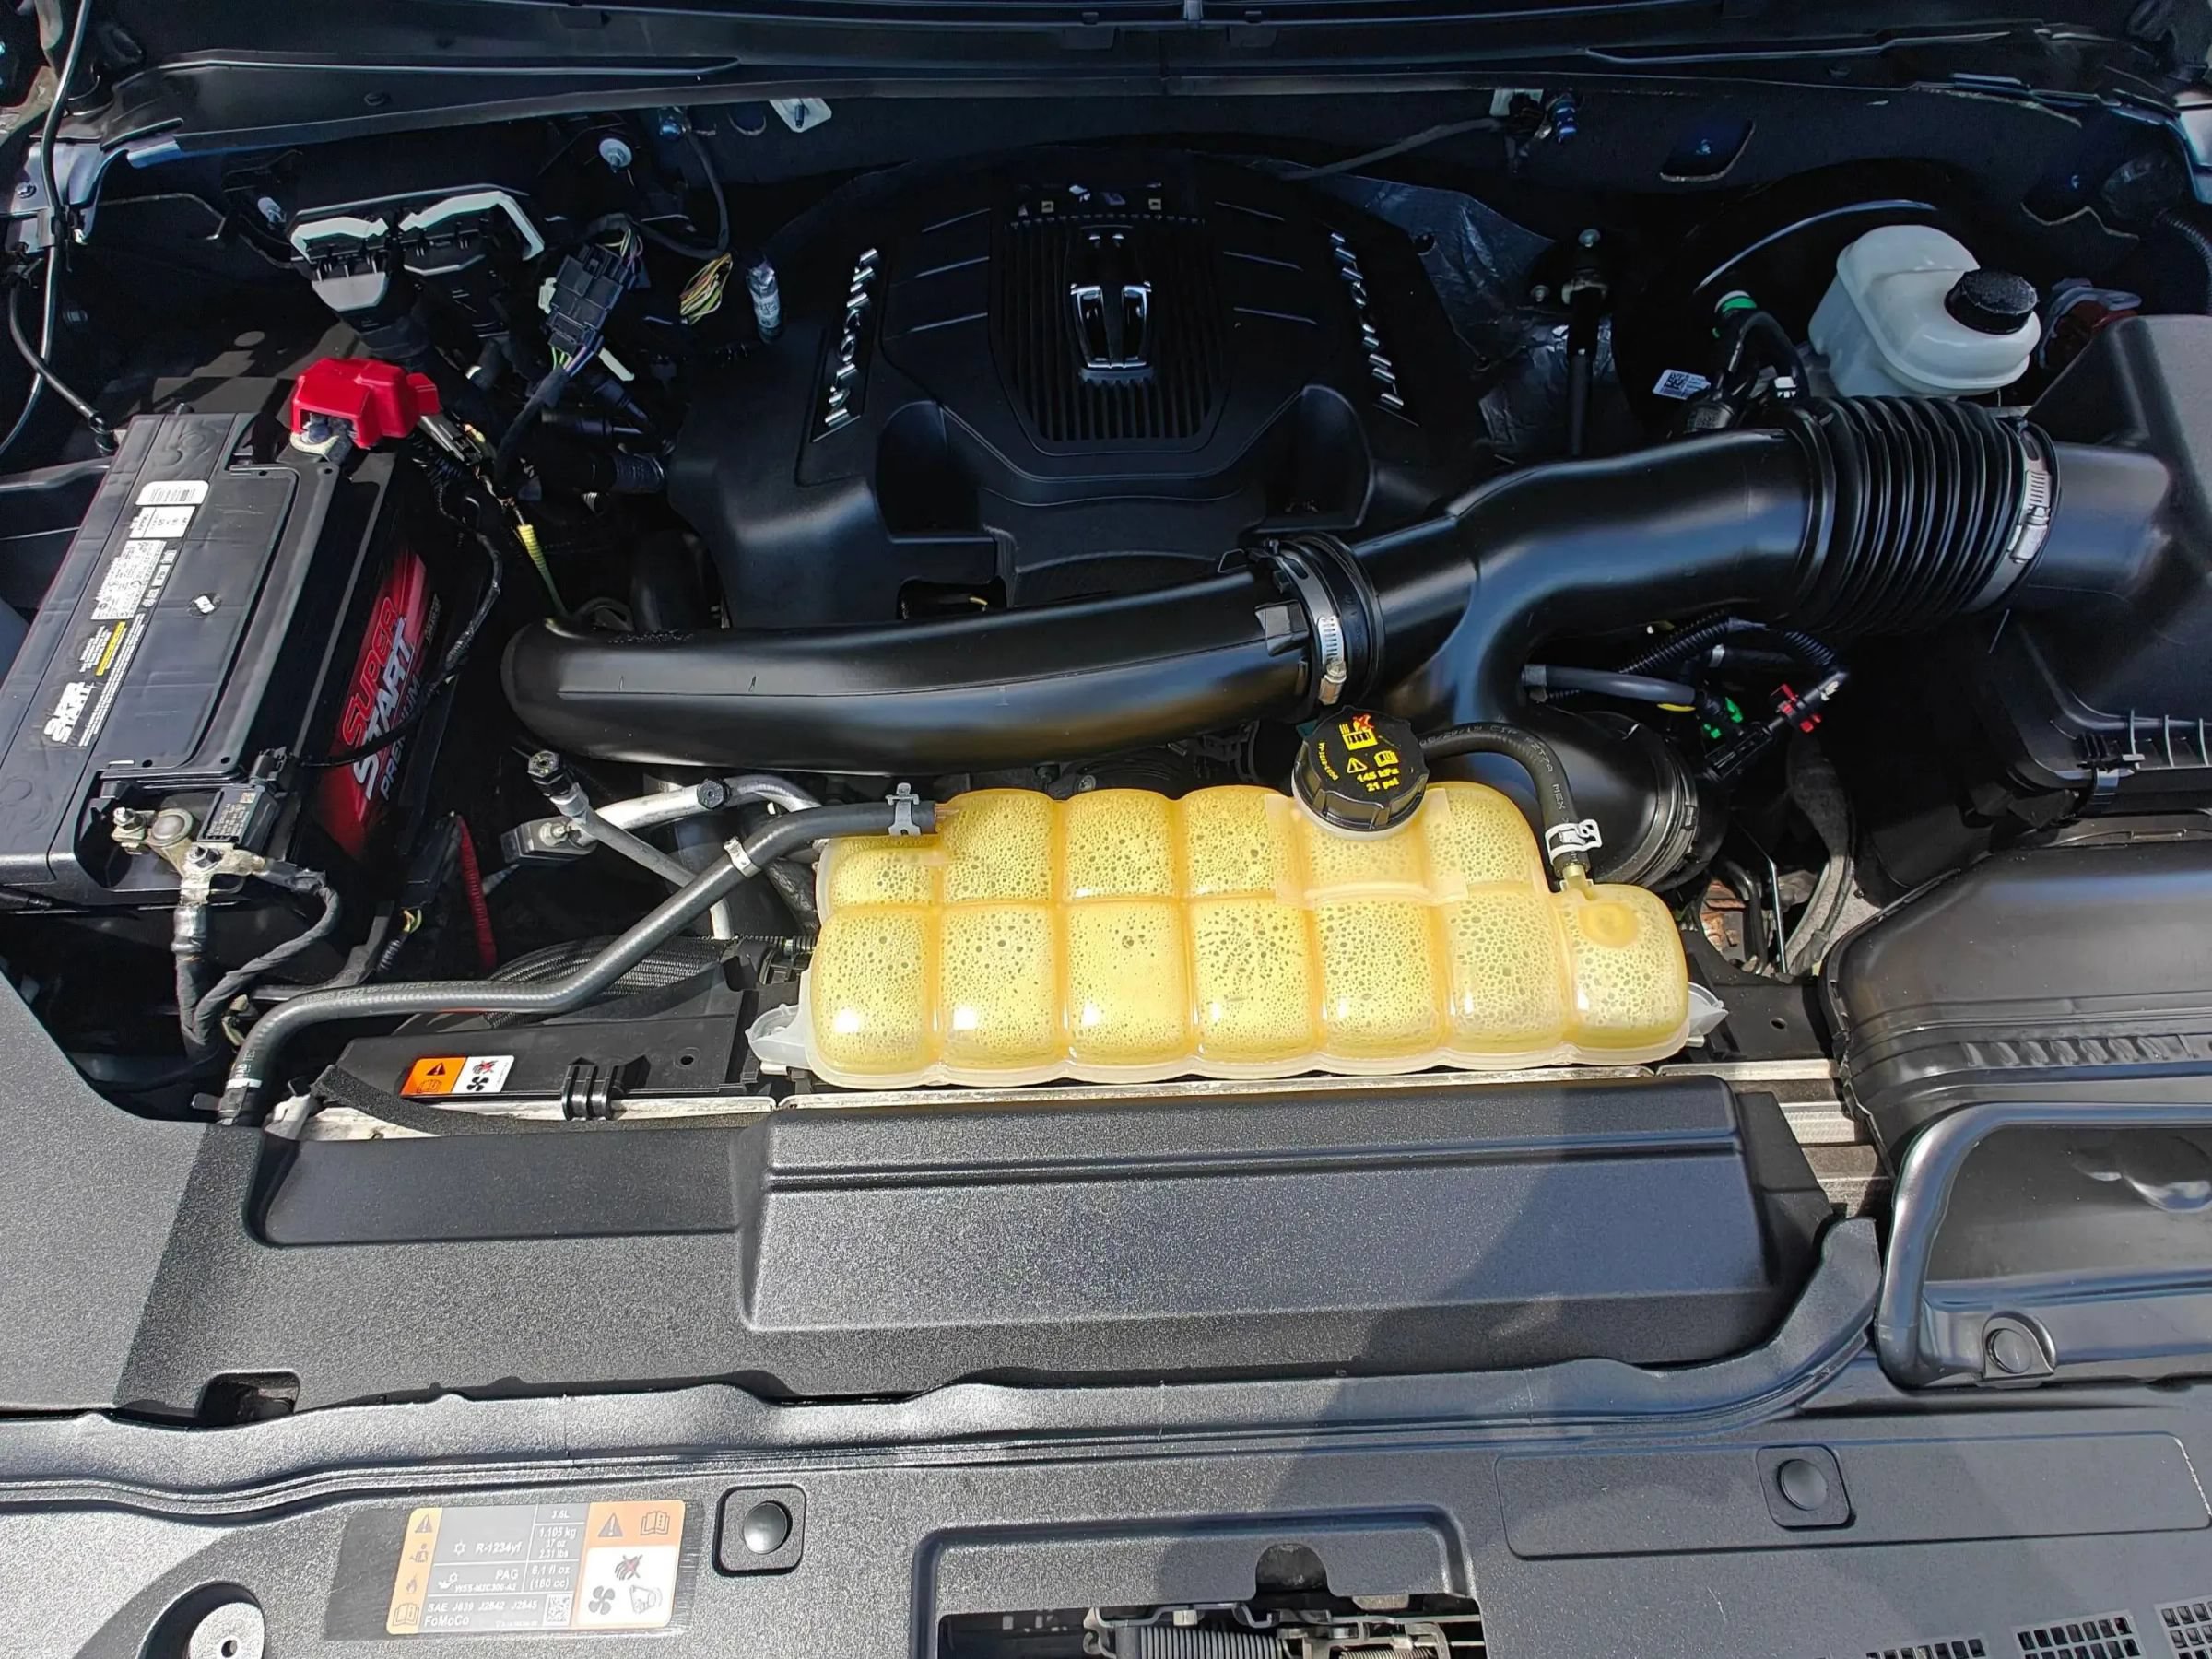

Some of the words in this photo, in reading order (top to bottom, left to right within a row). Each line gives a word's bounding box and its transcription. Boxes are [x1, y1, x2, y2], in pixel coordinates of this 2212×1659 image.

[342, 596, 398, 746] SUPER
[353, 617, 415, 801] START
[1357, 771, 1377, 782] 145
[1378, 768, 1399, 778] kPa
[1366, 782, 1380, 792] 21
[1382, 777, 1399, 790] psi
[1552, 783, 1567, 810] MEX
[539, 1527, 562, 1538] 1.105
[564, 1526, 577, 1538] kg
[475, 1541, 523, 1555] R-1234yf
[495, 1569, 519, 1581] PAG
[558, 1566, 571, 1574] oz
[427, 1602, 449, 1612] SAE
[424, 1615, 470, 1628] FoMoCo
